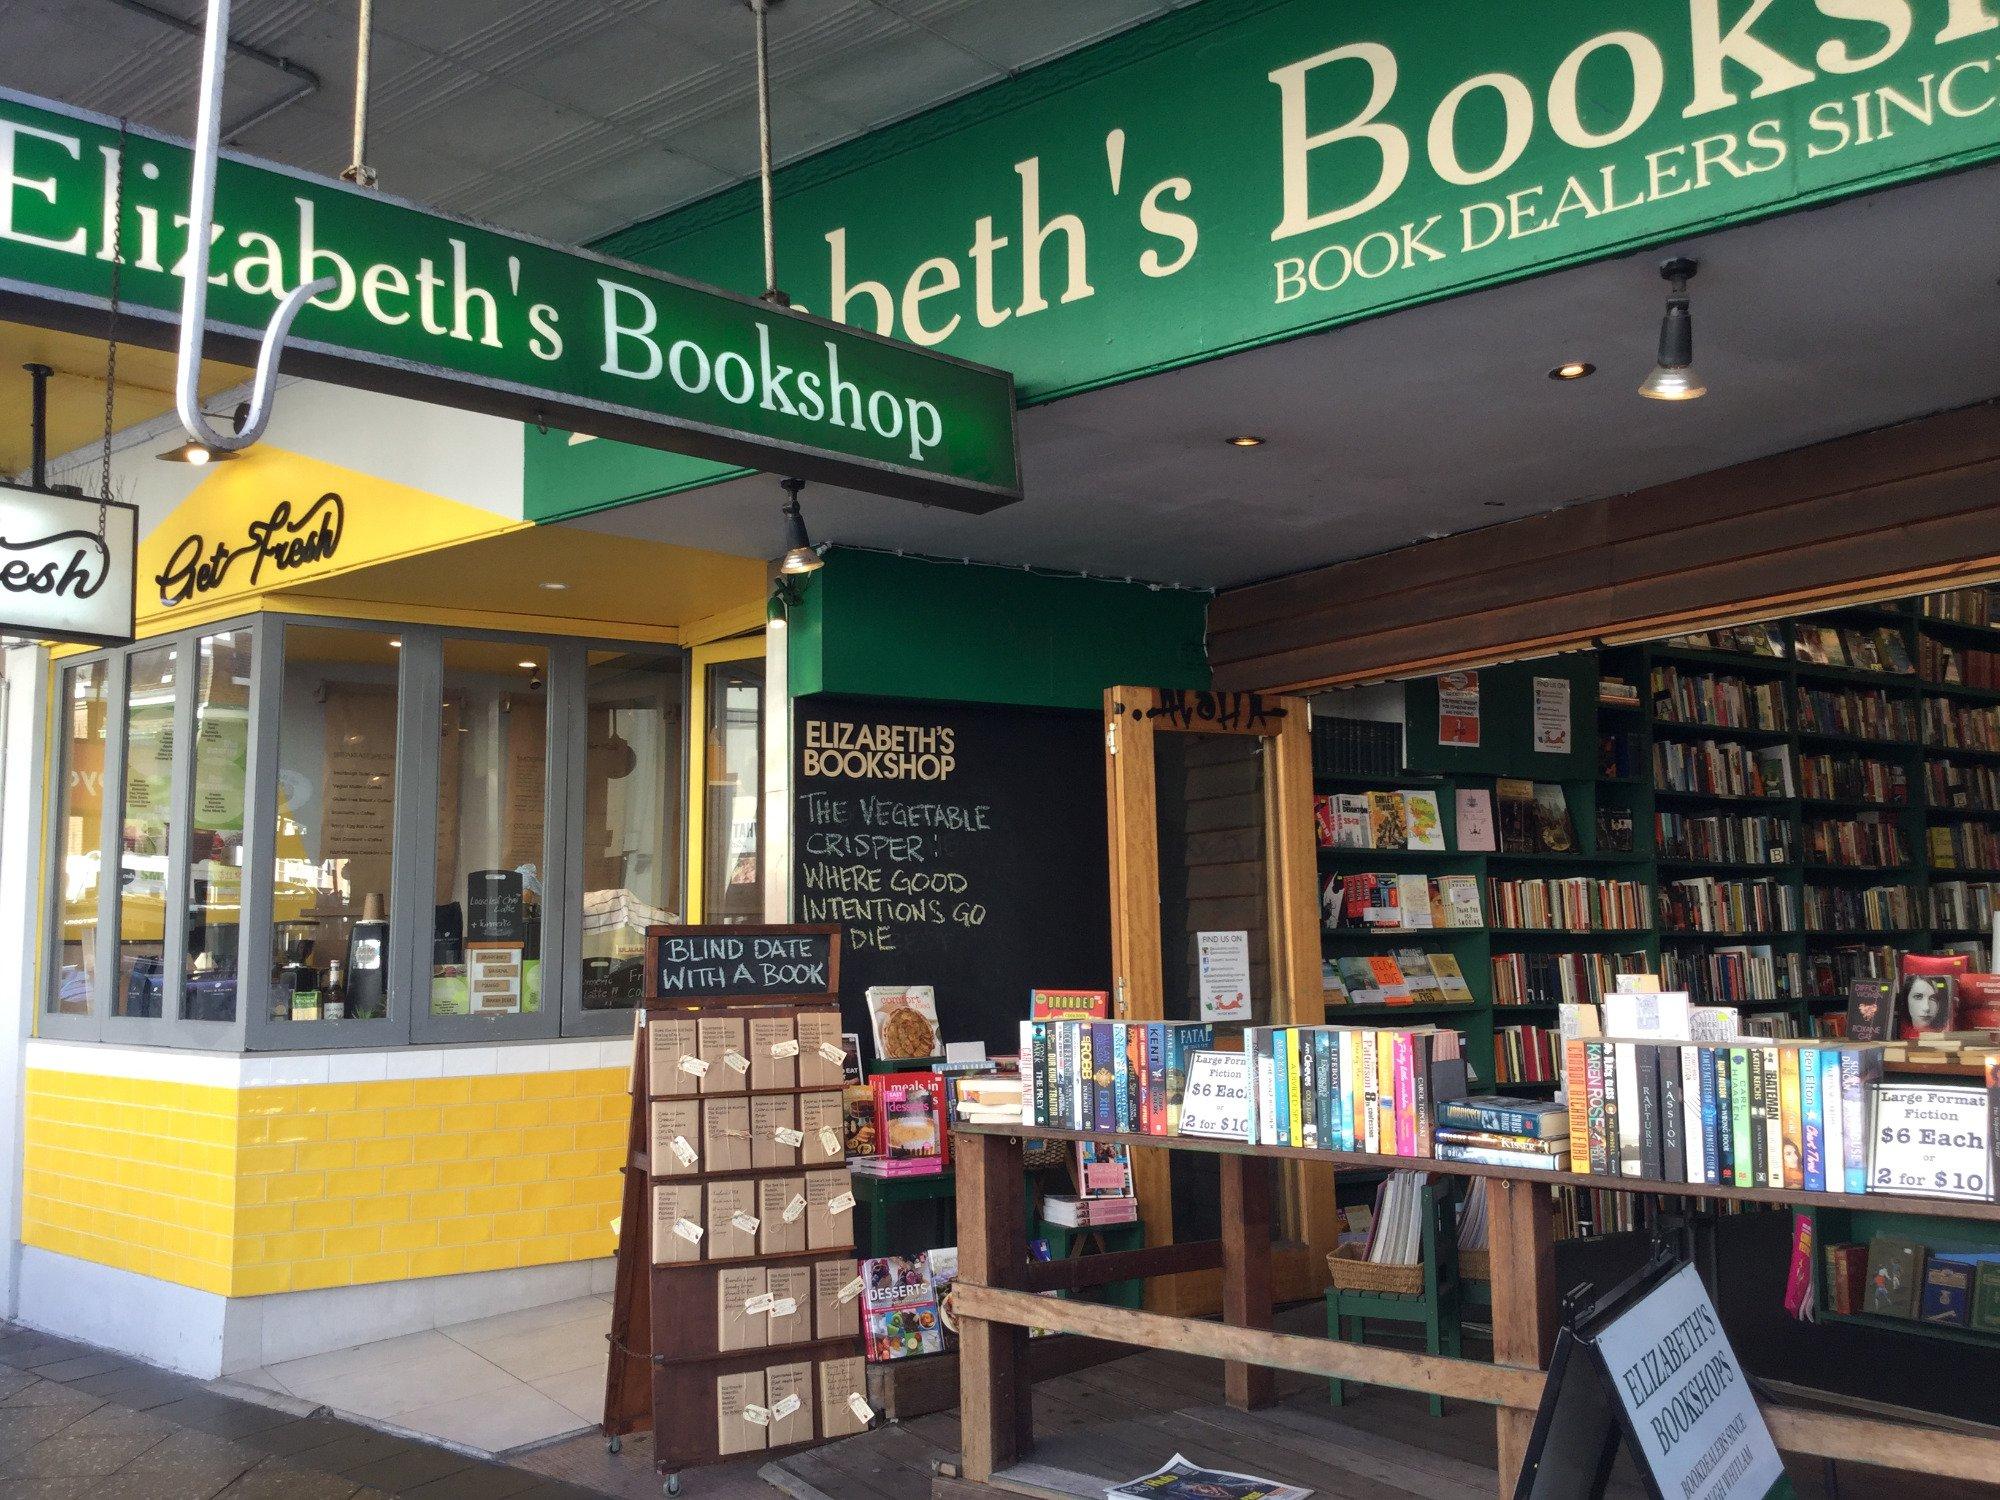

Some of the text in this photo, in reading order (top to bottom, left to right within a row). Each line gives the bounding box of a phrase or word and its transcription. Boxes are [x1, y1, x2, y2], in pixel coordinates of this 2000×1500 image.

[1267, 0, 2000, 241] Books
[1274, 55, 2000, 304] BOOK DEALERS SINC
[824, 127, 1199, 346] beth's
[0, 119, 942, 461] Elizabeth's Bookshop
[156, 492, 345, 606] Get Fresh
[0, 531, 110, 600] esh
[805, 720, 955, 754] ELIZABETH'S
[804, 749, 955, 780] BOOKSHOP
[799, 791, 992, 832] THE VEGETABLE
[1772, 849, 1782, 861] B
[803, 862, 969, 893] WHERE GOOD
[803, 895, 986, 927] INTENTIONS GO
[665, 938, 813, 962] BLIND DATE
[850, 926, 896, 952] DIE
[663, 966, 725, 991] WITH
[733, 963, 756, 985] A
[759, 962, 826, 986] BOOK
[881, 995, 921, 1004] comfort
[1064, 1025, 1072, 1077] NICCI FRENCH
[1150, 1028, 1159, 1063] KENT
[1180, 1029, 1211, 1044] FATAL
[846, 1067, 859, 1075] EAT
[1048, 1053, 1056, 1066] OUR
[1048, 1067, 1057, 1082] KIND
[1195, 1055, 1246, 1066] Large Form
[1209, 1069, 1241, 1079] Fiction
[1304, 1054, 1314, 1087] Cleeves
[1331, 1048, 1339, 1090] LIFEBOAT
[1363, 1040, 1373, 1088] Patterson
[1605, 1056, 1614, 1077] BLACK
[1702, 1051, 1710, 1071] JAMES
[1805, 1050, 1813, 1072] Ben
[1842, 1056, 1850, 1091] DUNCAN
[1850, 1060, 1859, 1089] SUSAN
[891, 1080, 939, 1091] meals in
[1192, 1083, 1247, 1099] $6 Eac
[1587, 1044, 1605, 1128] KAREN ROSE
[1606, 1079, 1615, 1100] GLASS
[1703, 1072, 1712, 1104] PATTERSON
[1752, 1052, 1762, 1100] KATHY REICHS
[1805, 1076, 1815, 1106] Elton
[889, 1102, 930, 1112] desserts
[1036, 1089, 1044, 1109] PREY
[1049, 1089, 1057, 1116] TRAITOR
[1732, 1068, 1740, 1121] HIAASEN
[1766, 1073, 1779, 1120] BATEMAN
[1881, 1092, 1985, 1106] Large Format
[1185, 1114, 1196, 1128] 2
[1200, 1119, 1216, 1129] for
[1570, 1090, 1586, 1133] RICHARD
[1643, 1087, 1653, 1147] RAPTURE
[1666, 1080, 1676, 1148] PASSION
[1721, 1110, 1729, 1133] WRONG
[1904, 1108, 1959, 1121] Fiction
[1572, 1136, 1588, 1161] FORD
[1881, 1126, 1984, 1150] $6 Each
[1877, 1168, 1983, 1192] 2 for $10
[870, 1283, 928, 1301] DESSERTS
[1622, 1303, 1717, 1408] ELIZABETH'S
[1649, 1350, 1734, 1456] BOOKSHOPS
[1680, 1412, 1748, 1500] BOOKDEALERS SINCE
[1722, 1443, 1754, 1491] WHITLAM
